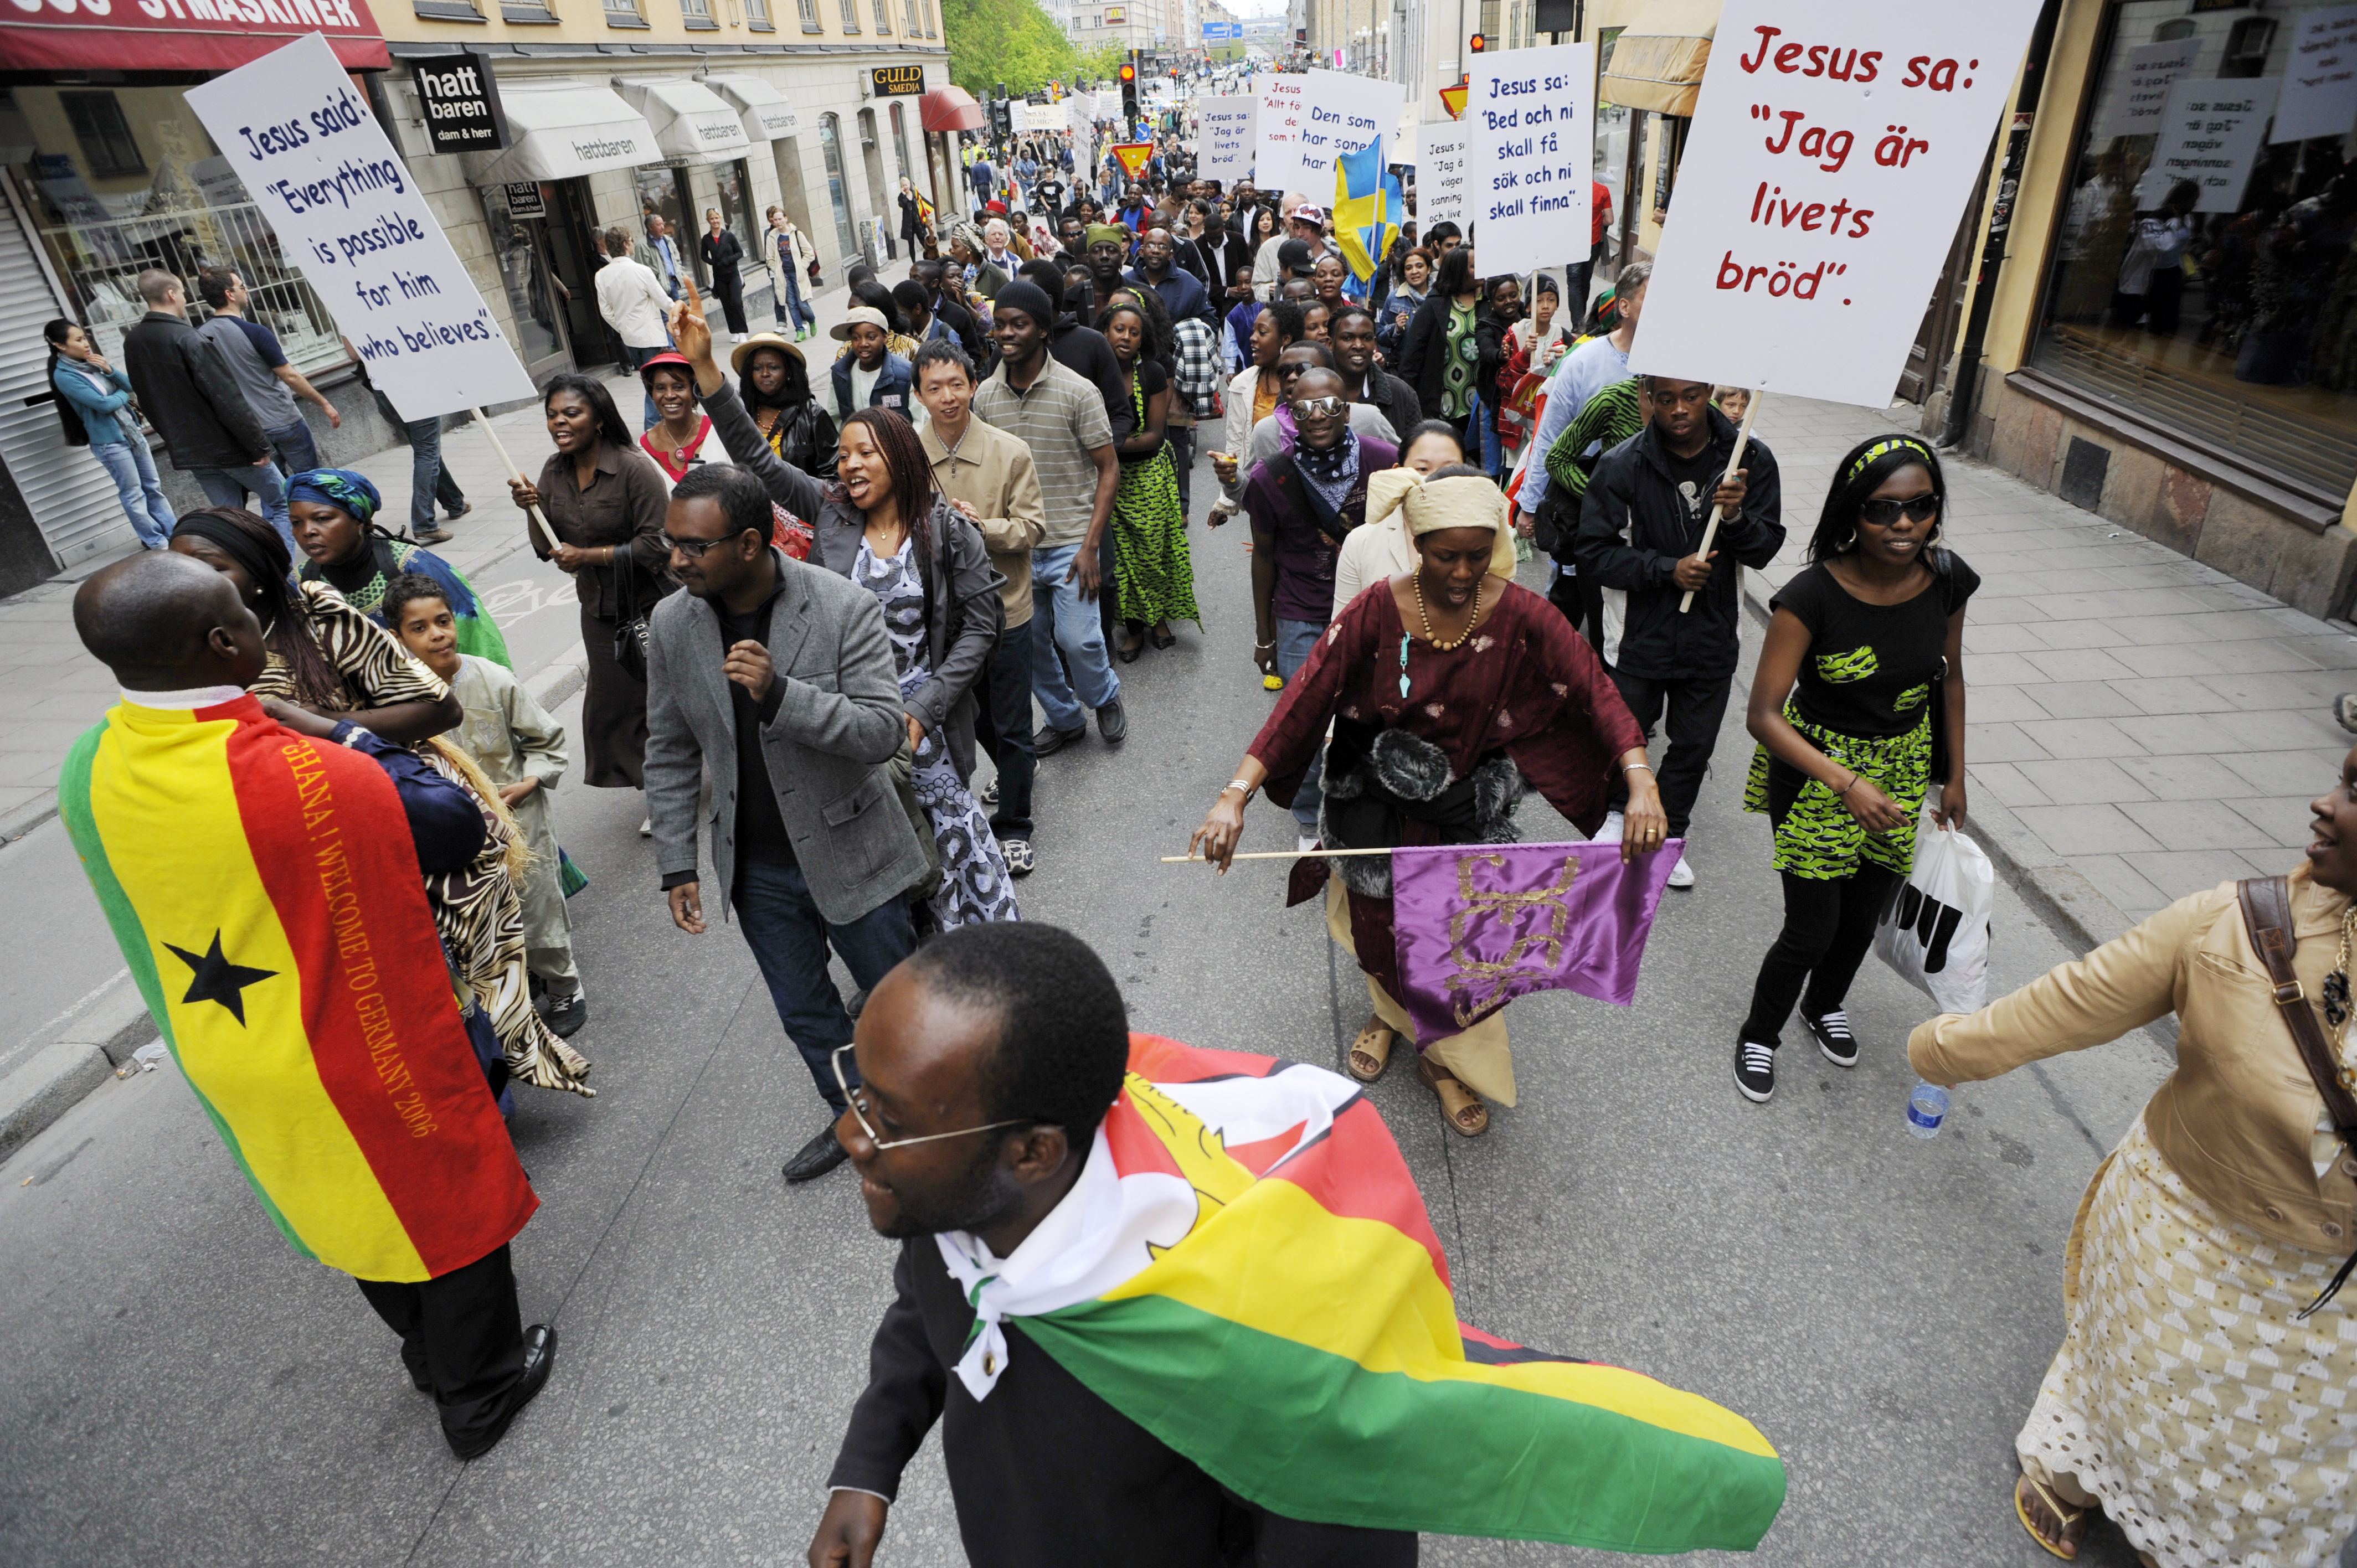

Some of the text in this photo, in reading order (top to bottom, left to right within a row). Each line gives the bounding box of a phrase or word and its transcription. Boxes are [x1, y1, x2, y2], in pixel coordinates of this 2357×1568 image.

[1740, 25, 1979, 92] Jesus sa:
[419, 66, 481, 97] hatt
[874, 66, 922, 84] GULD
[1490, 74, 1568, 98] Jesus sa:
[888, 82, 920, 94] SMEDJA
[1272, 82, 1301, 94] Jesus
[428, 100, 487, 119] baren
[1264, 96, 1285, 109] "Allt
[239, 87, 367, 161] Jesus said:
[760, 114, 798, 131] hattbaren
[1205, 112, 1232, 122] Jesus
[1311, 106, 1375, 130] Den som
[1482, 101, 1573, 130] "Bed och ni
[438, 128, 492, 141] dam & herr
[697, 123, 742, 141] hattbaren
[1210, 126, 1246, 137] "Jag är
[1302, 128, 1327, 145] har
[1751, 104, 1929, 173] "Jag är
[572, 138, 636, 161] hattbaren
[1214, 140, 1240, 149] livets
[1429, 143, 1454, 155] Jesus
[1498, 132, 1557, 159] skall få
[1212, 153, 1241, 163] bröd".
[1302, 153, 1327, 170] har
[1434, 160, 1454, 172] "Jag
[266, 157, 404, 214] "Everything
[1493, 162, 1571, 190] sök och ni
[511, 195, 537, 204] baren
[1431, 193, 1461, 206] sanning
[1490, 189, 1581, 220] skall finna".
[1750, 182, 1875, 238] livets
[1429, 209, 1461, 223] och live
[308, 211, 424, 267] is possible
[1716, 250, 1851, 306] bröd".
[356, 271, 441, 311] for him
[357, 308, 500, 360] who believes".
[881, 394, 902, 408] PH
[281, 739, 335, 832] GHANA
[315, 838, 369, 961] WELCOME
[345, 960, 378, 992] TO
[354, 992, 411, 1096] GERMANY
[394, 1092, 438, 1139] 2006
